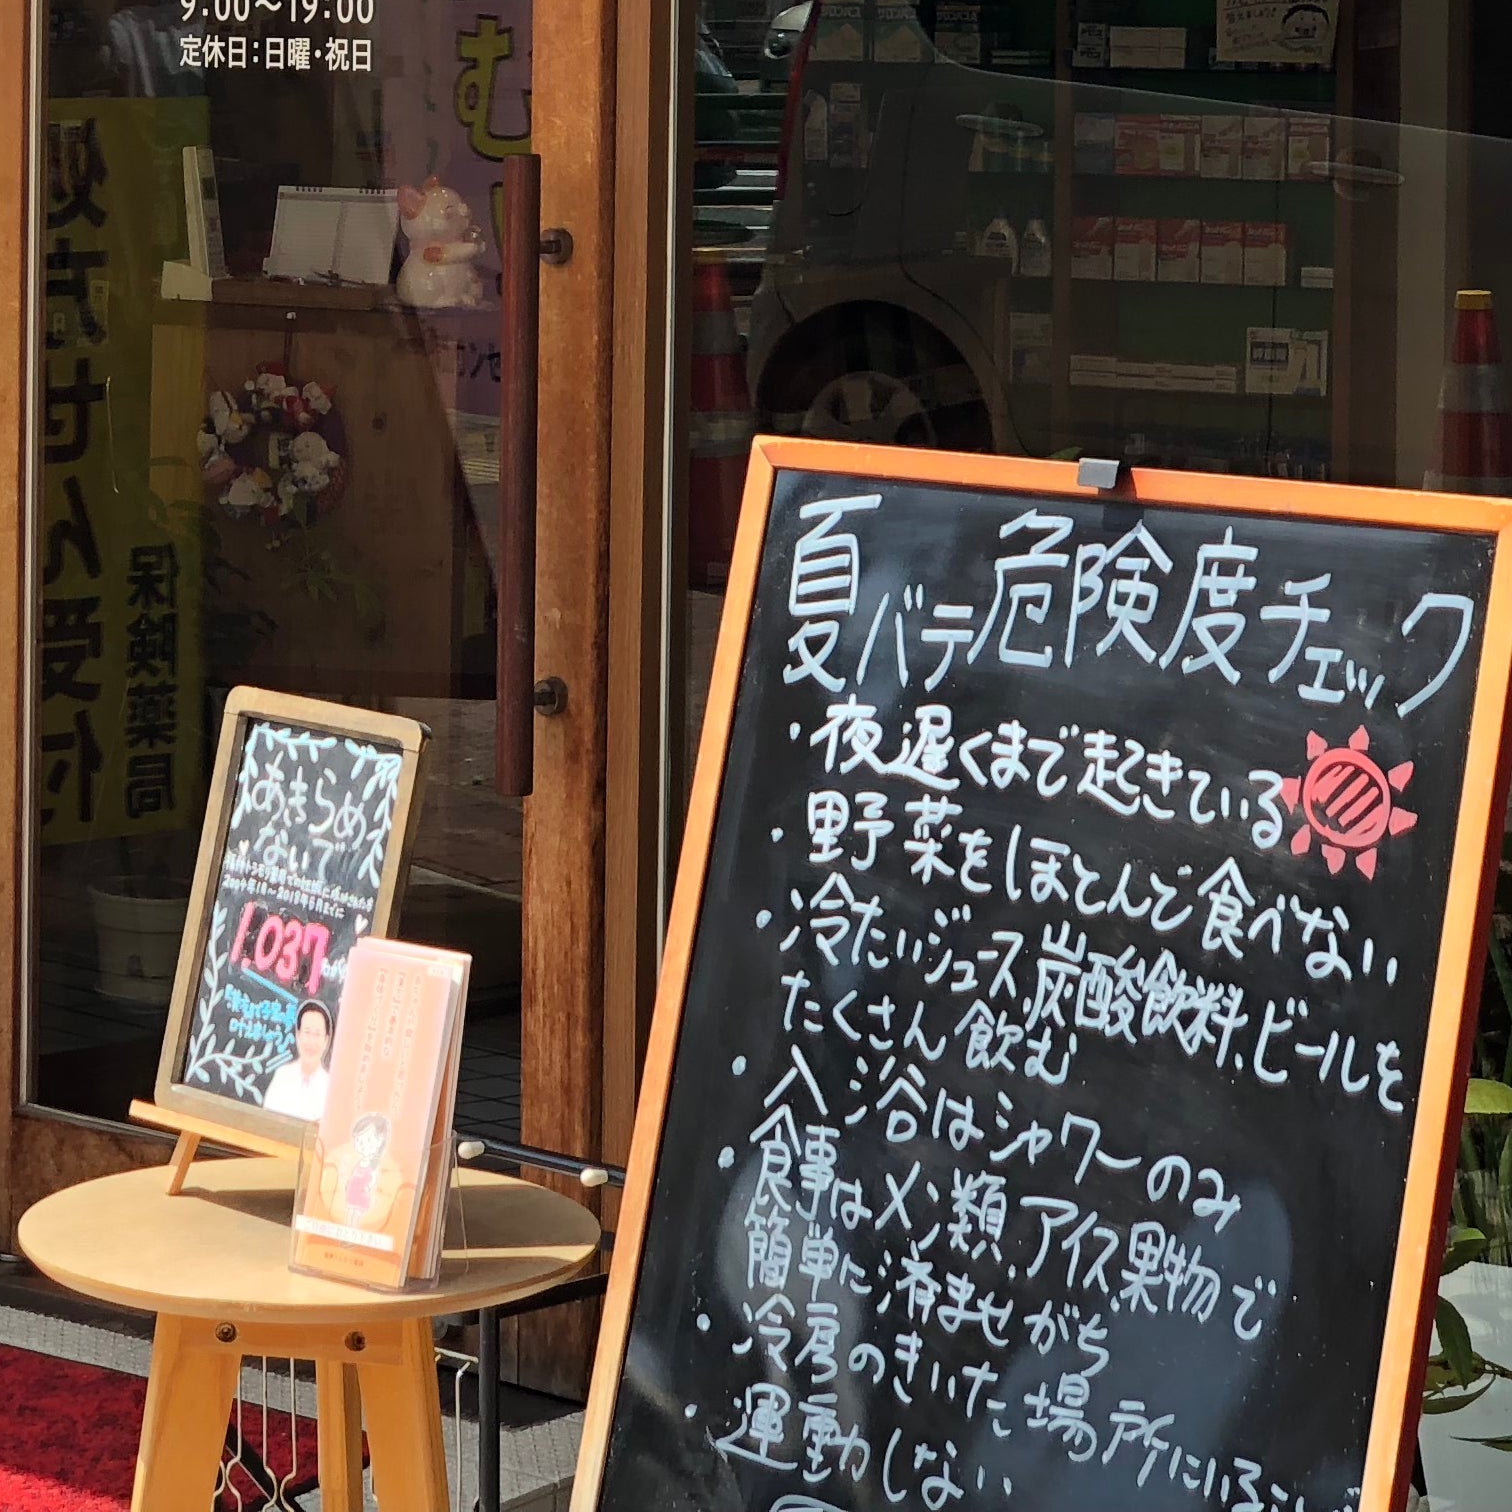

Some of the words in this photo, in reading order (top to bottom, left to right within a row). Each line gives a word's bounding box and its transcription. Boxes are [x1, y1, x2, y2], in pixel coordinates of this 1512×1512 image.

[783, 494, 1474, 719] 夏バテ危険度チェック
[252, 750, 367, 850] あきらめ
[781, 971, 1077, 1084] たくさん飲む
[744, 1206, 1110, 1377] 簡単に済ませがち
